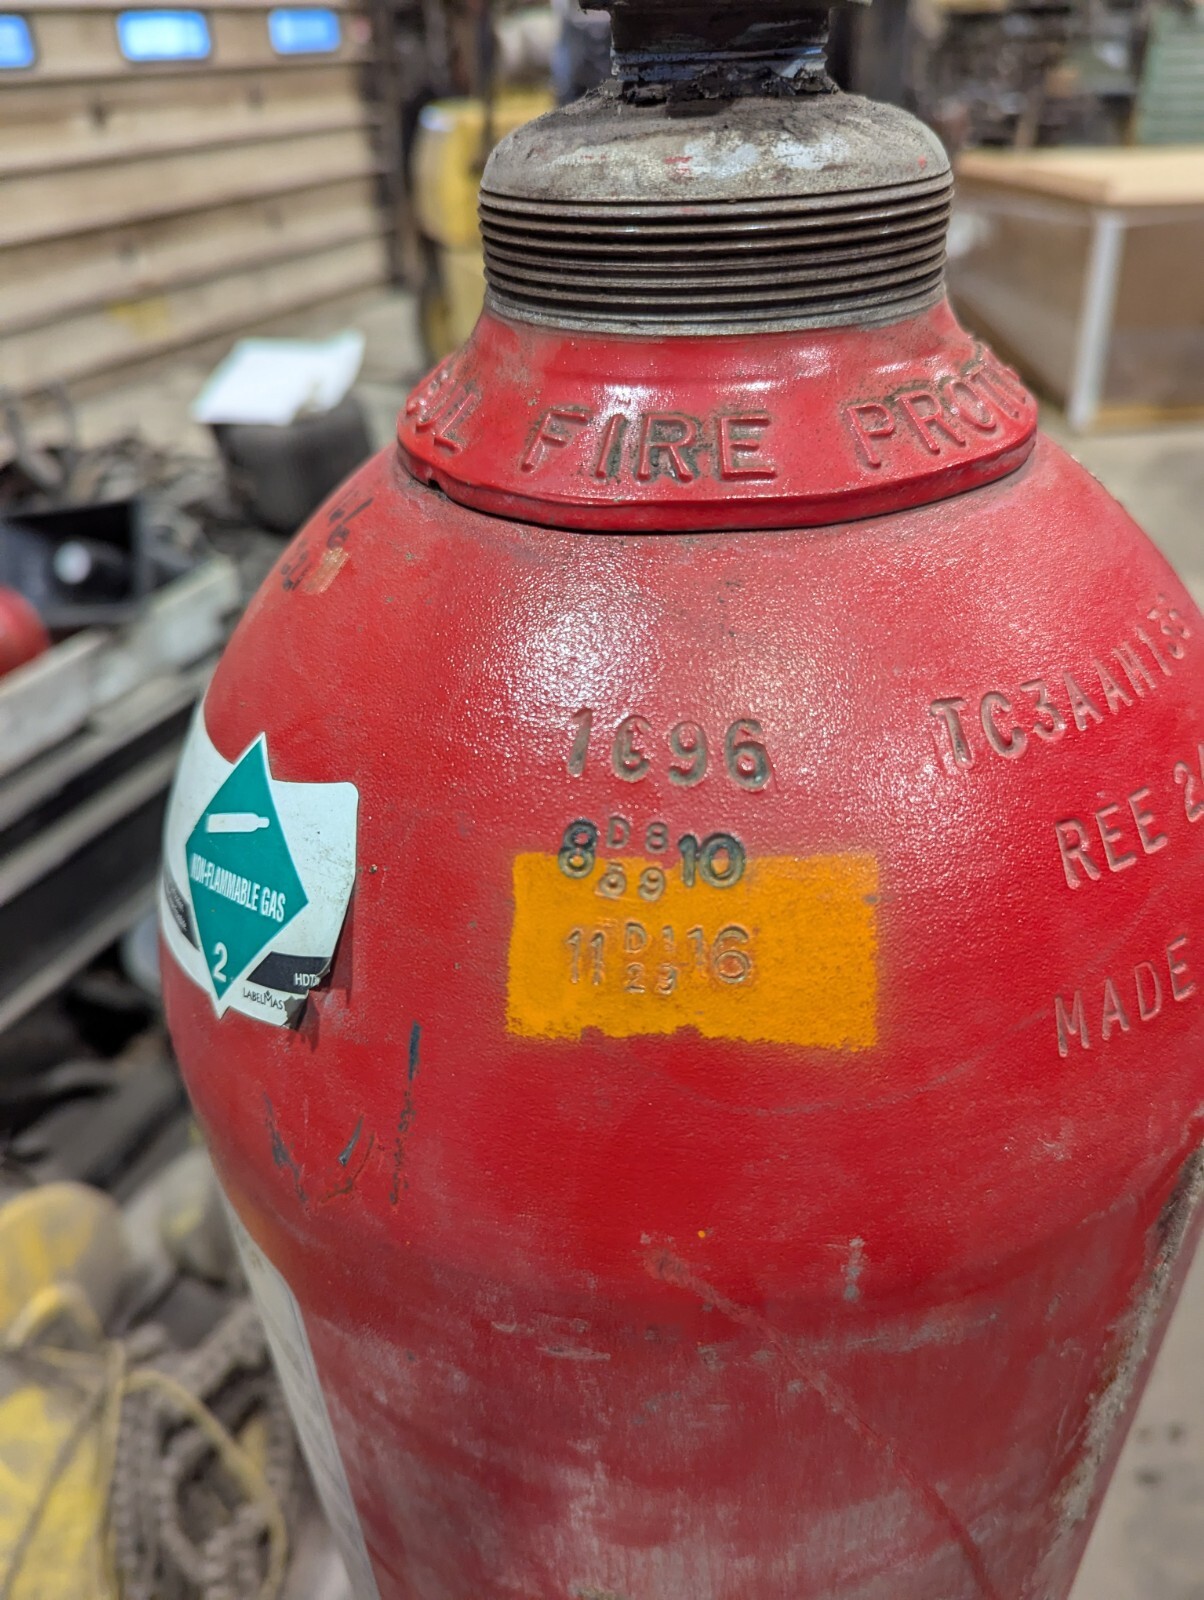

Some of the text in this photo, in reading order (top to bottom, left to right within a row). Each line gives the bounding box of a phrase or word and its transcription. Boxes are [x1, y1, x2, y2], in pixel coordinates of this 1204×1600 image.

[520, 406, 778, 482] FIRE
[558, 817, 598, 879] 8
[677, 832, 747, 889] 10
[1055, 786, 1169, 890] REE
[190, 852, 260, 911] NON-FLAMMABLE
[260, 886, 287, 923] GAS
[211, 941, 229, 983] 2
[686, 924, 753, 984] 16
[1054, 934, 1196, 1058] MADE
